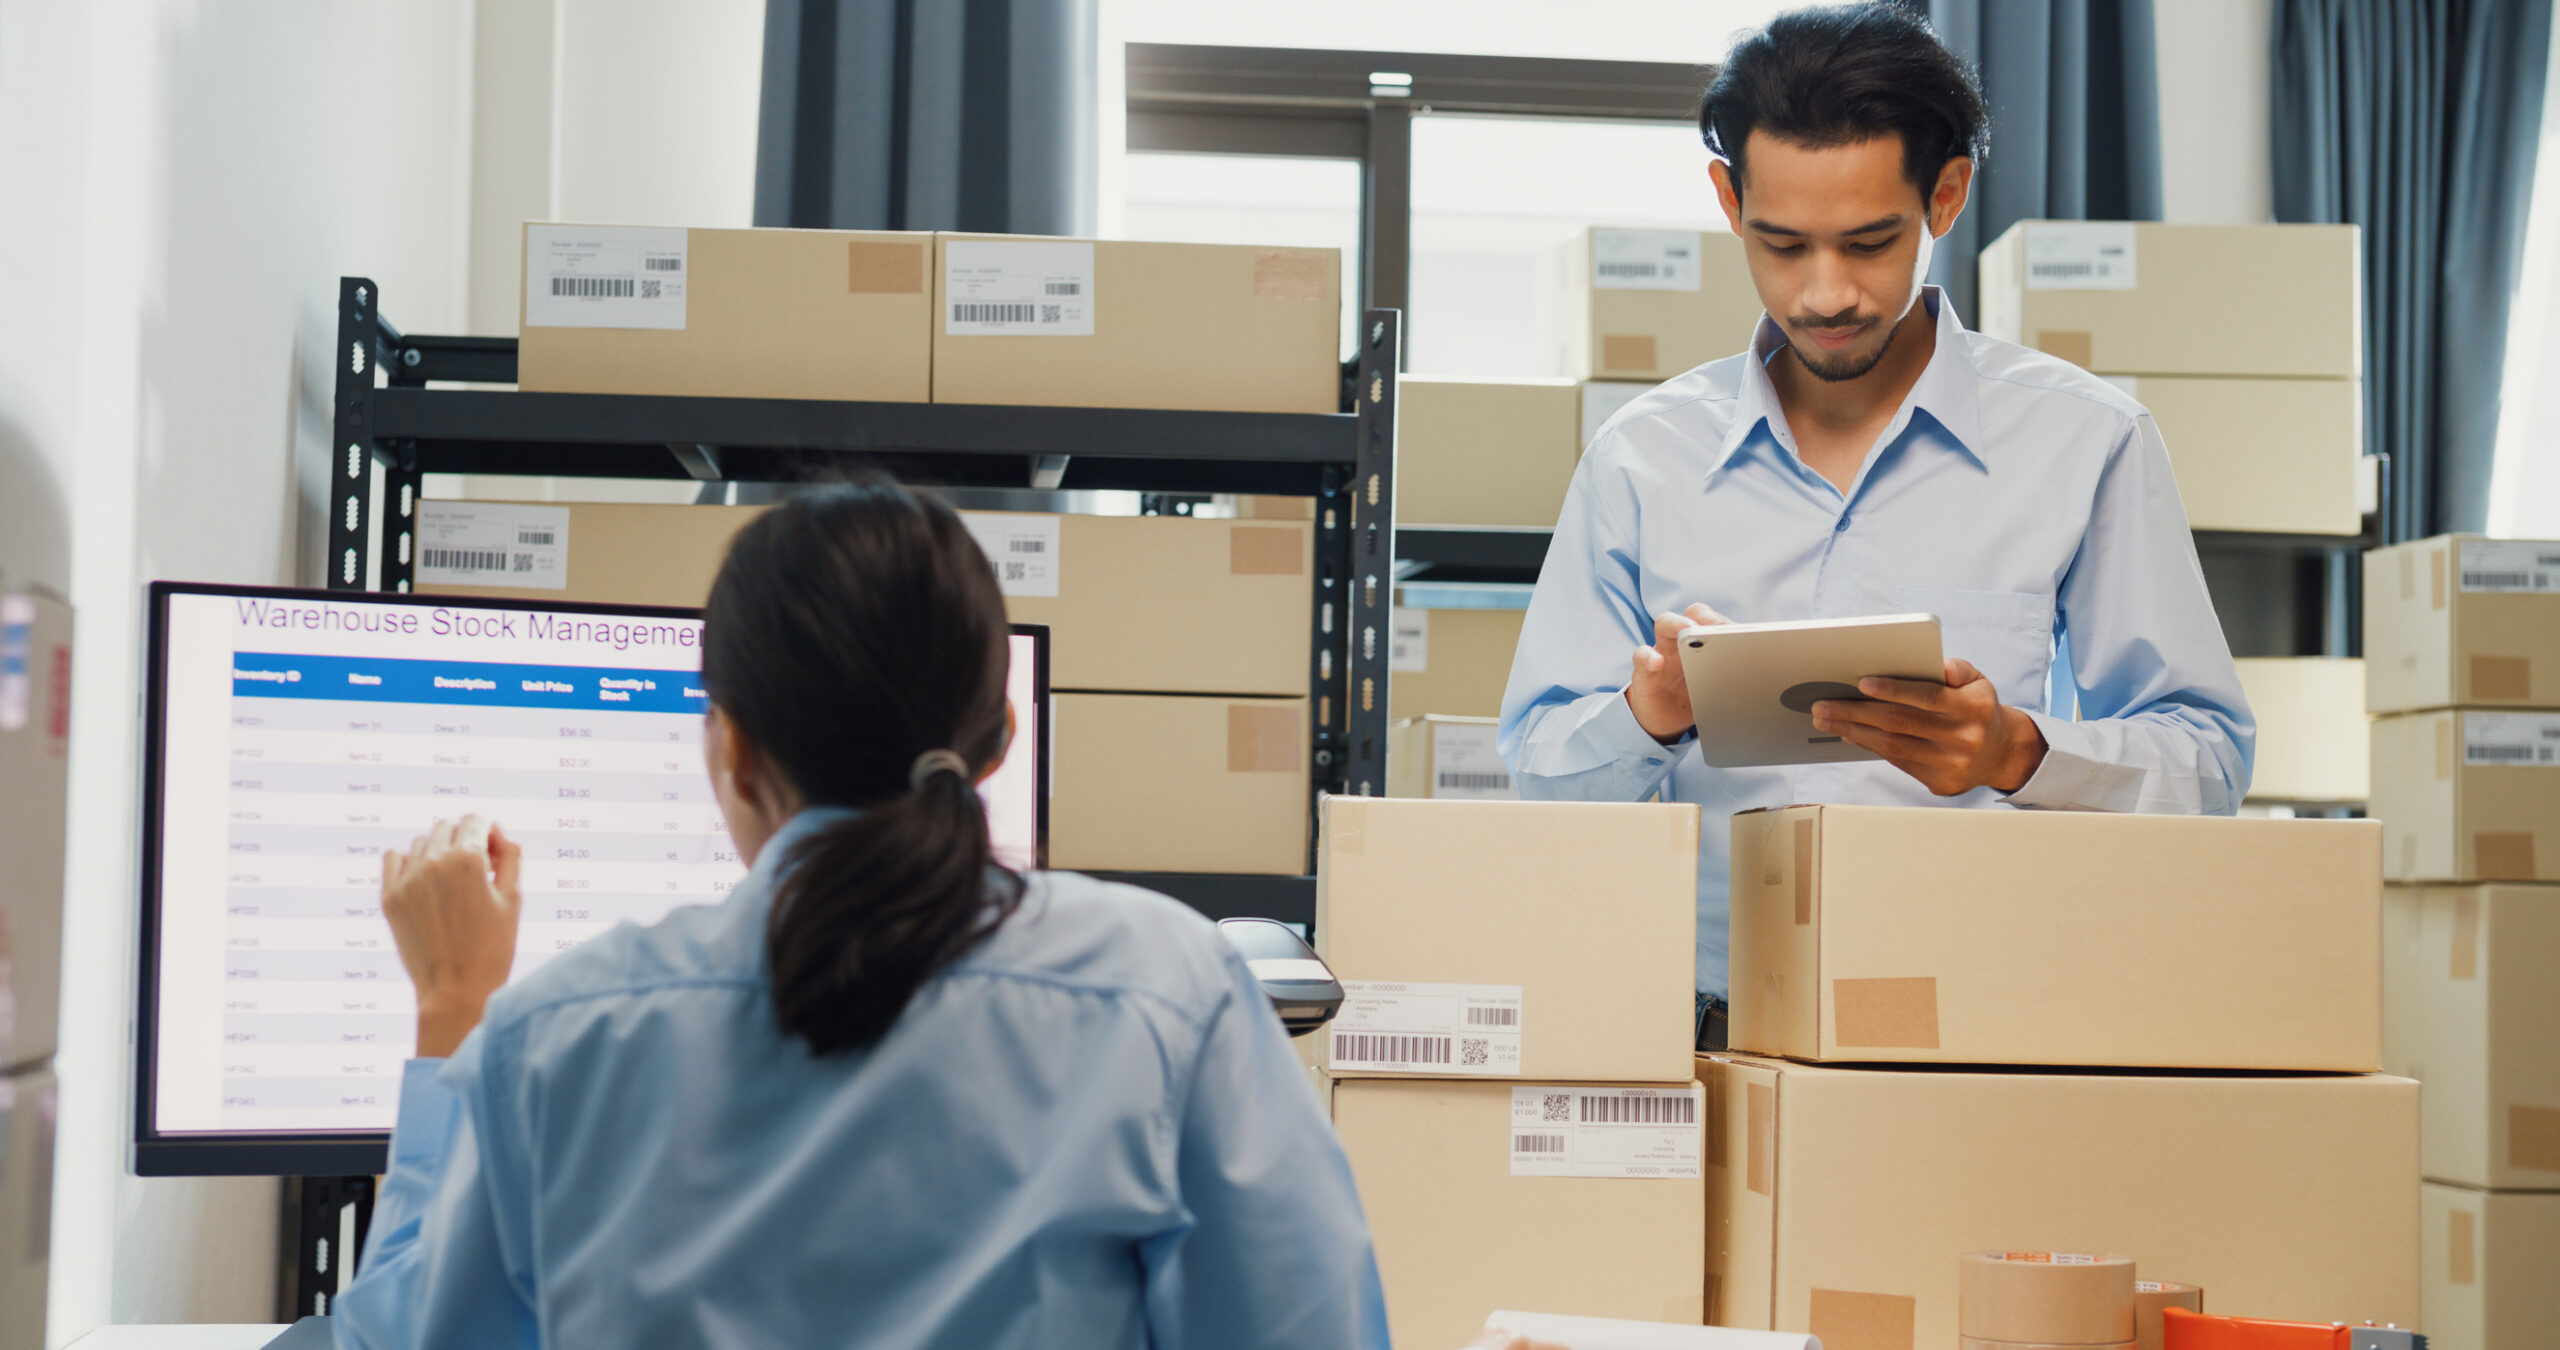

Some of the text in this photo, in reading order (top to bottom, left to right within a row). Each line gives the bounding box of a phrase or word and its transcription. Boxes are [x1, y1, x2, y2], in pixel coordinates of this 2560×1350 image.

[236, 600, 704, 651] Warehouse Stock Manageme
[233, 669, 286, 683] Inventory
[348, 673, 381, 685] Name
[434, 676, 496, 690] Description
[522, 680, 574, 692] Unit Price
[599, 677, 644, 691] Quantity
[341, 1033, 362, 1042] Item
[341, 1064, 361, 1073] Item
[340, 1096, 361, 1105] Item
[1667, 1167, 1696, 1175] Number
